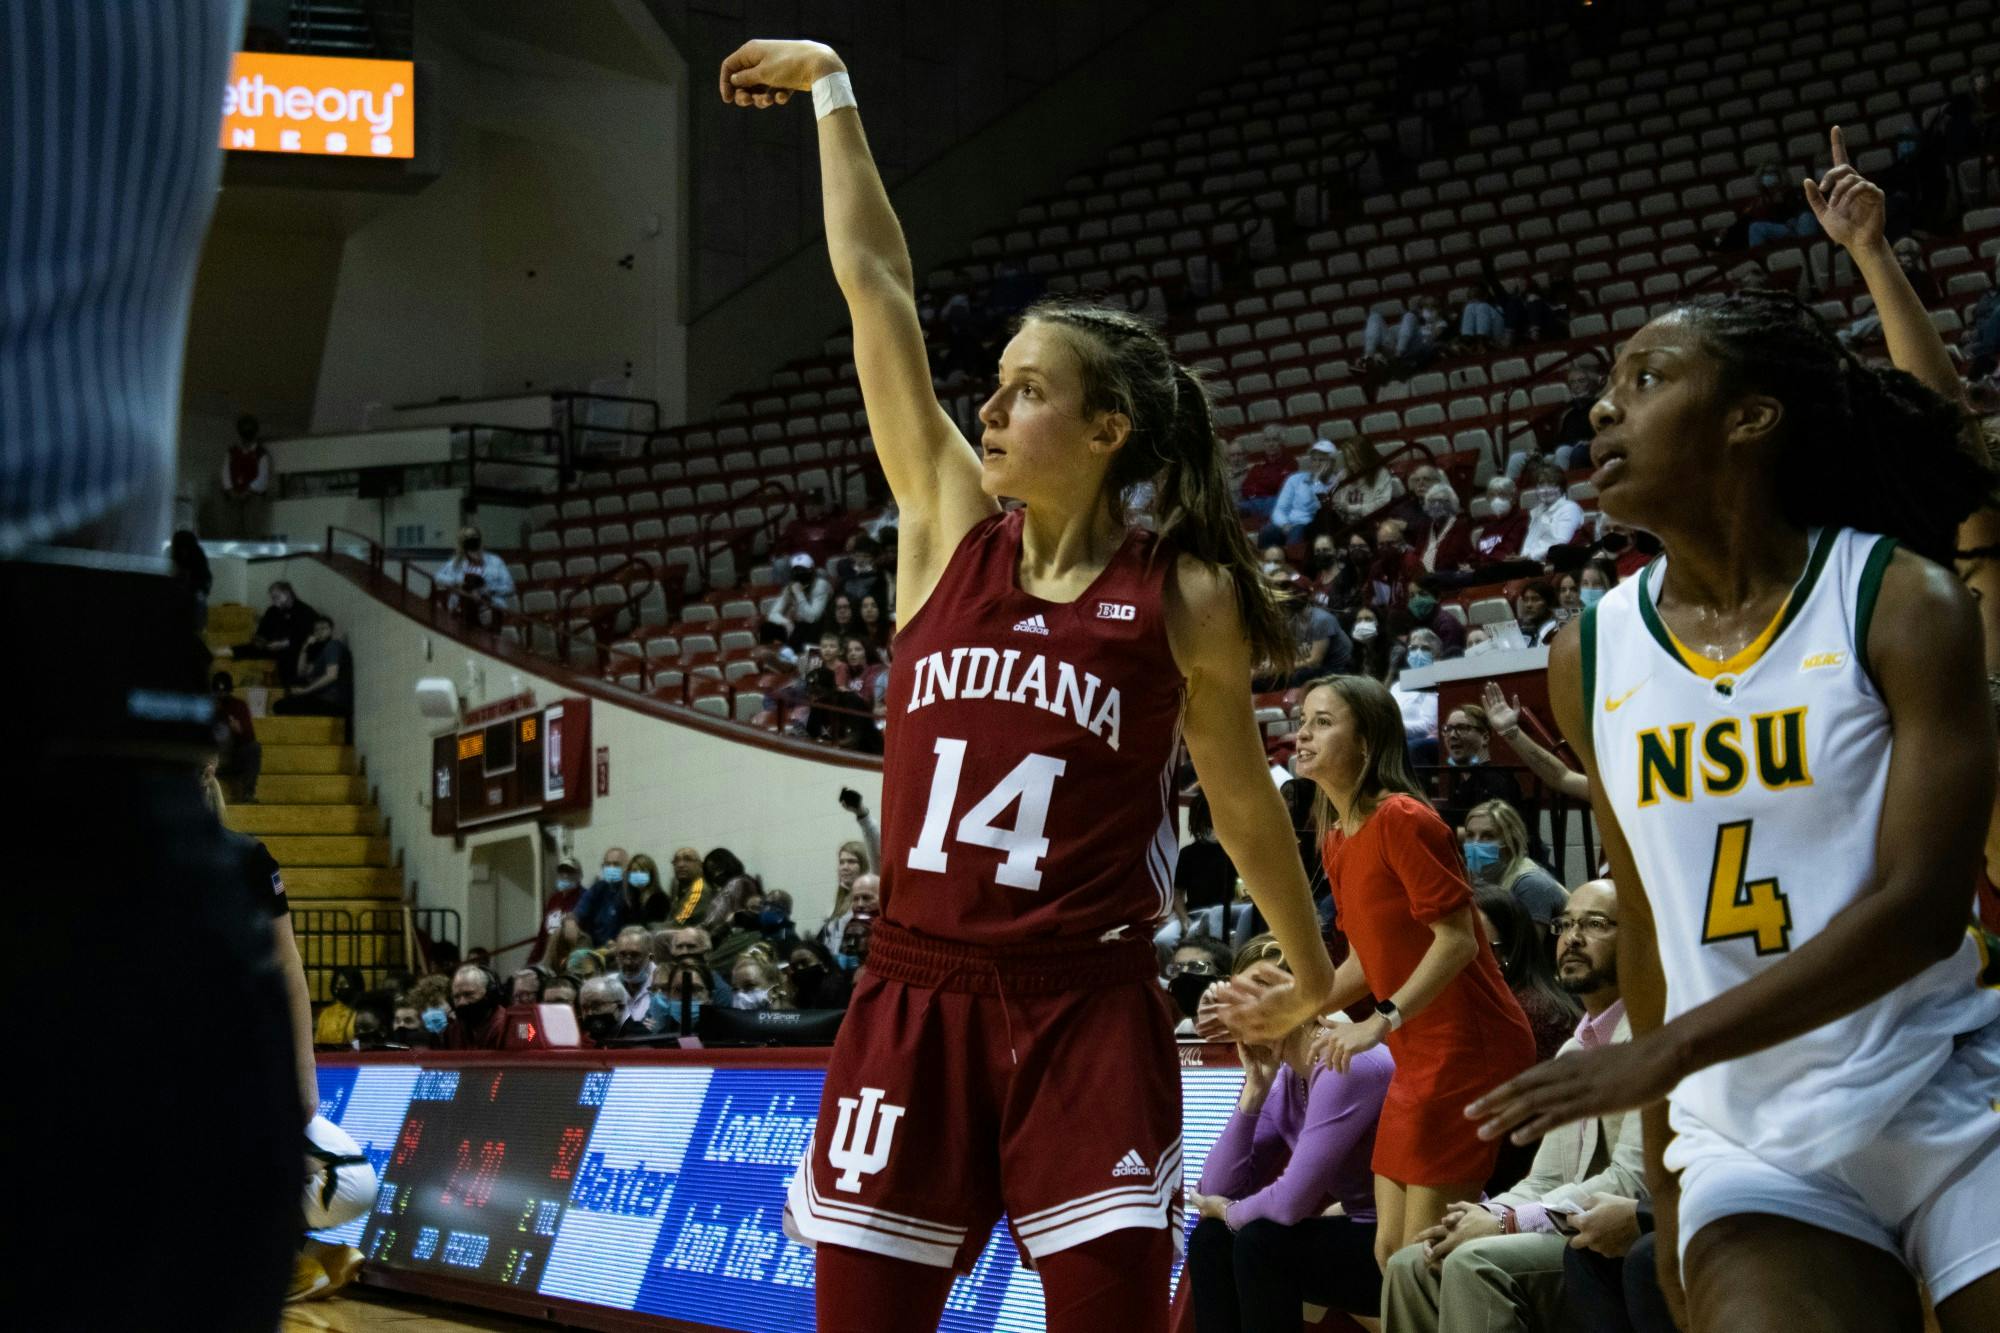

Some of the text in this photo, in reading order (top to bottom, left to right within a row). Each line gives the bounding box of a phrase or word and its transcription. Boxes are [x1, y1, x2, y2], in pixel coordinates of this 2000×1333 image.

[1013, 624, 1050, 636] adidas
[907, 648, 1121, 752] INDIANA
[1637, 706, 1813, 808] NSU
[907, 737, 1068, 891] 14
[1702, 818, 1792, 955] 4
[577, 1151, 681, 1217] Baxter
[1112, 1165, 1151, 1177] adidas
[662, 1203, 729, 1274] Join
[723, 1208, 780, 1280] the
